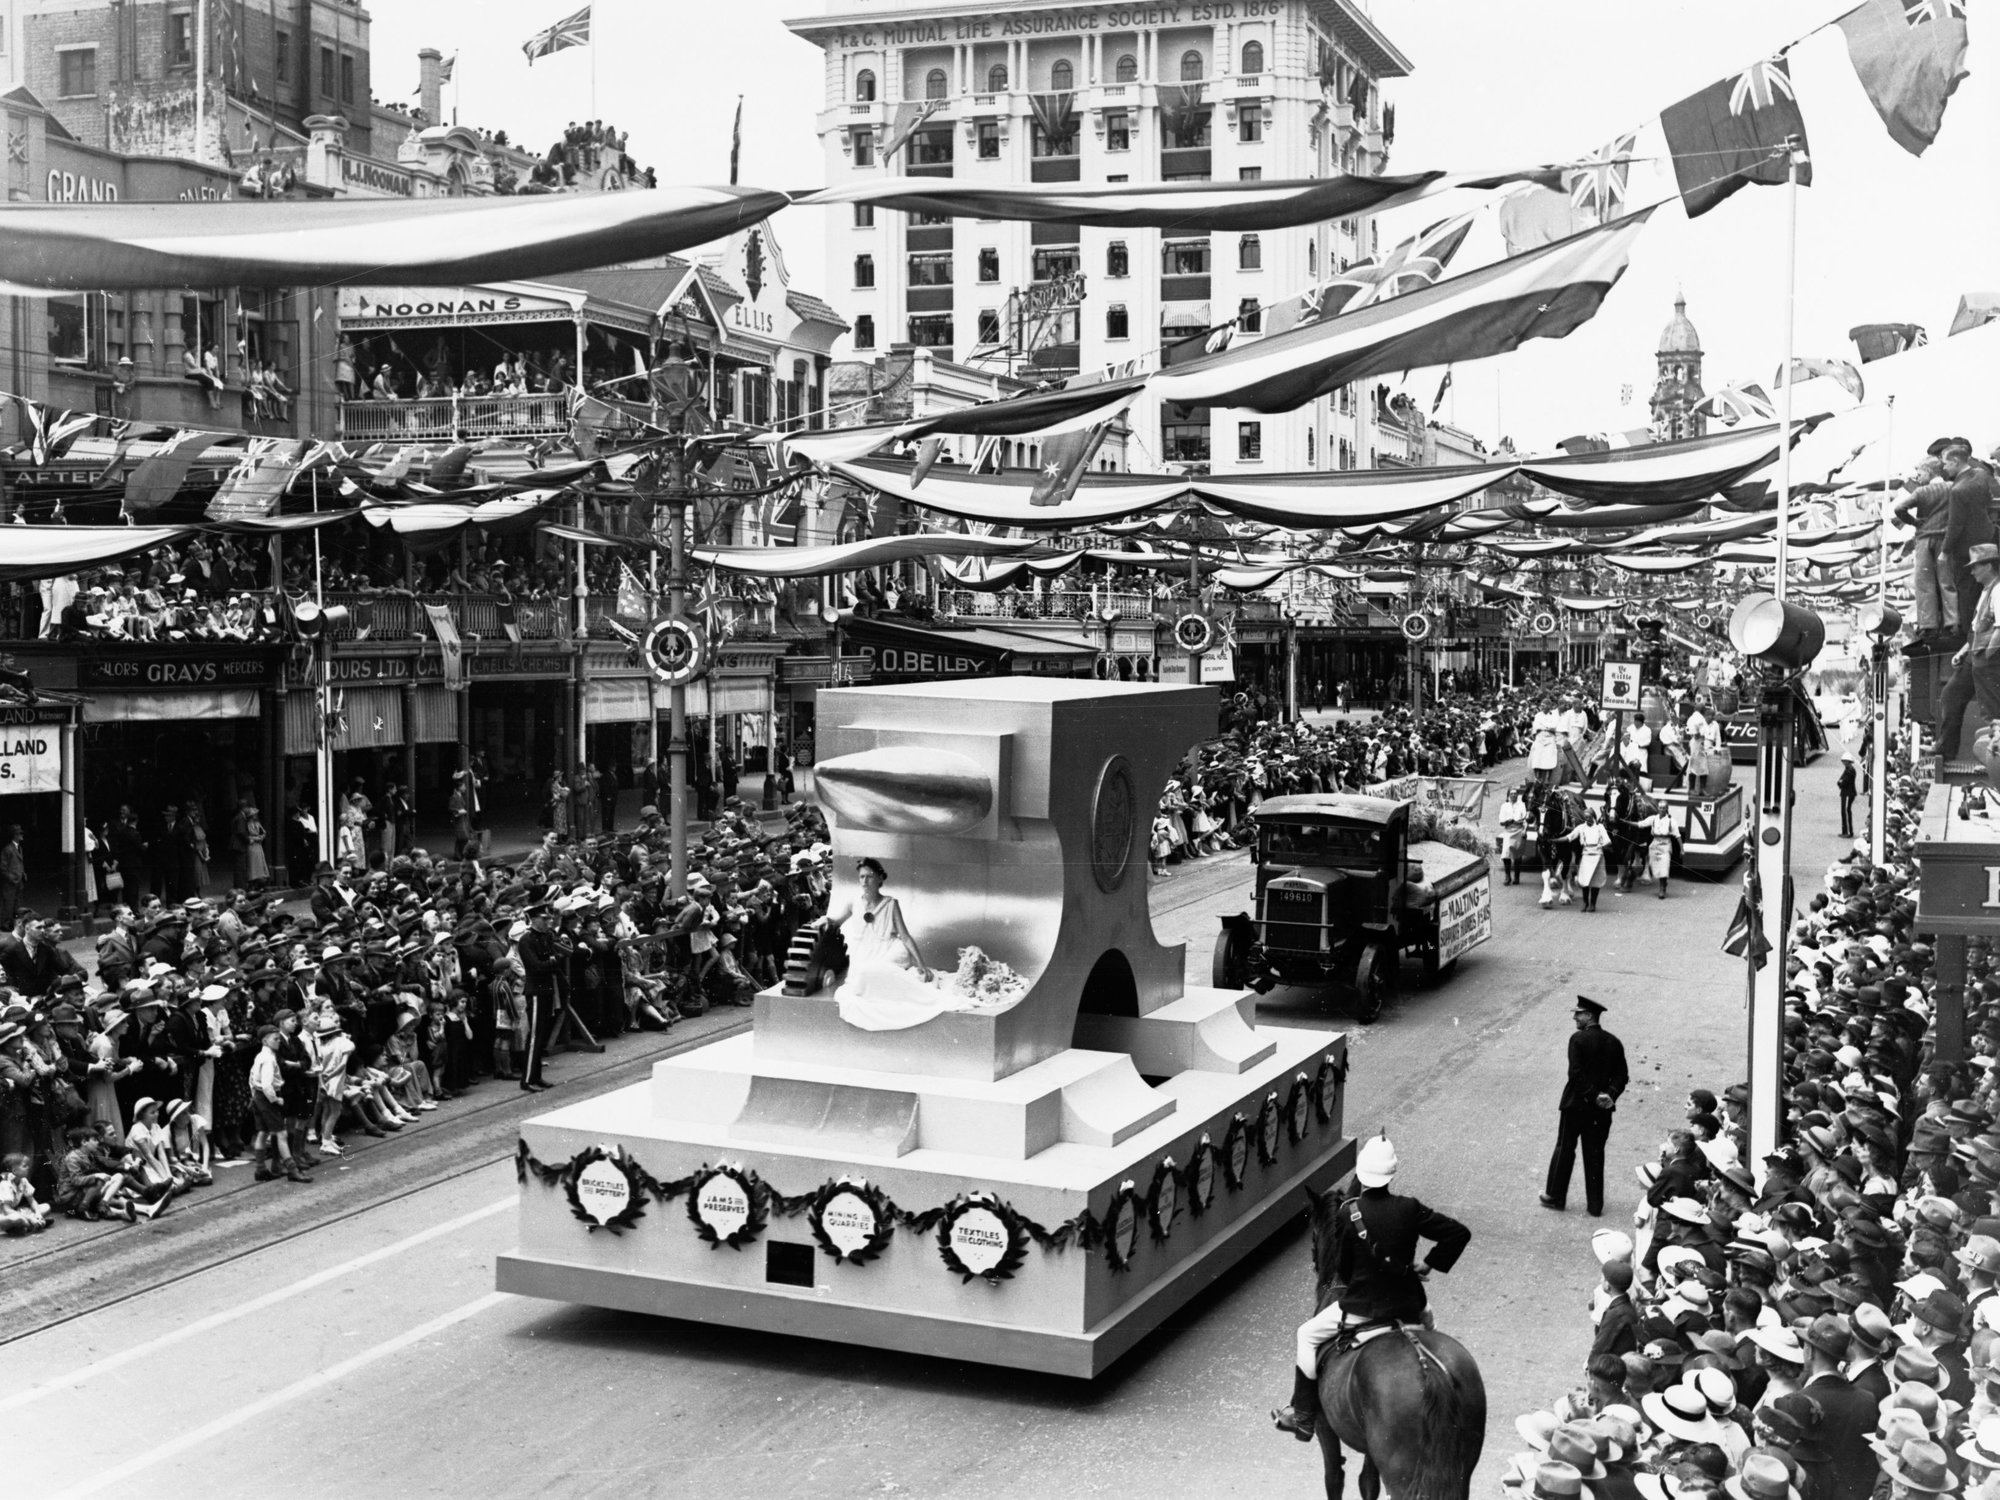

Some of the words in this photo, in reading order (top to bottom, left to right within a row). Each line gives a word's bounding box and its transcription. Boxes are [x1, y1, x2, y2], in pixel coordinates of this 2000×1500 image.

[883, 26, 947, 46] MUTUAL
[955, 22, 992, 40] LIFE
[1001, 13, 1099, 36] ASSURANCE
[1242, 0, 1279, 18] 1876
[47, 169, 118, 202] GRAND
[734, 305, 774, 334] ELLIS
[223, 660, 265, 676] MERCERS
[1448, 887, 1480, 922] MALTING
[594, 1187, 627, 1199] POTTERY
[706, 1195, 733, 1205] JAMS
[703, 1202, 746, 1215] PRESERVES
[827, 1210, 859, 1221] MINING
[828, 1217, 870, 1231] QUARRIES
[957, 1226, 1000, 1241] TEXTILES
[967, 1236, 1004, 1249] CLOTHING
